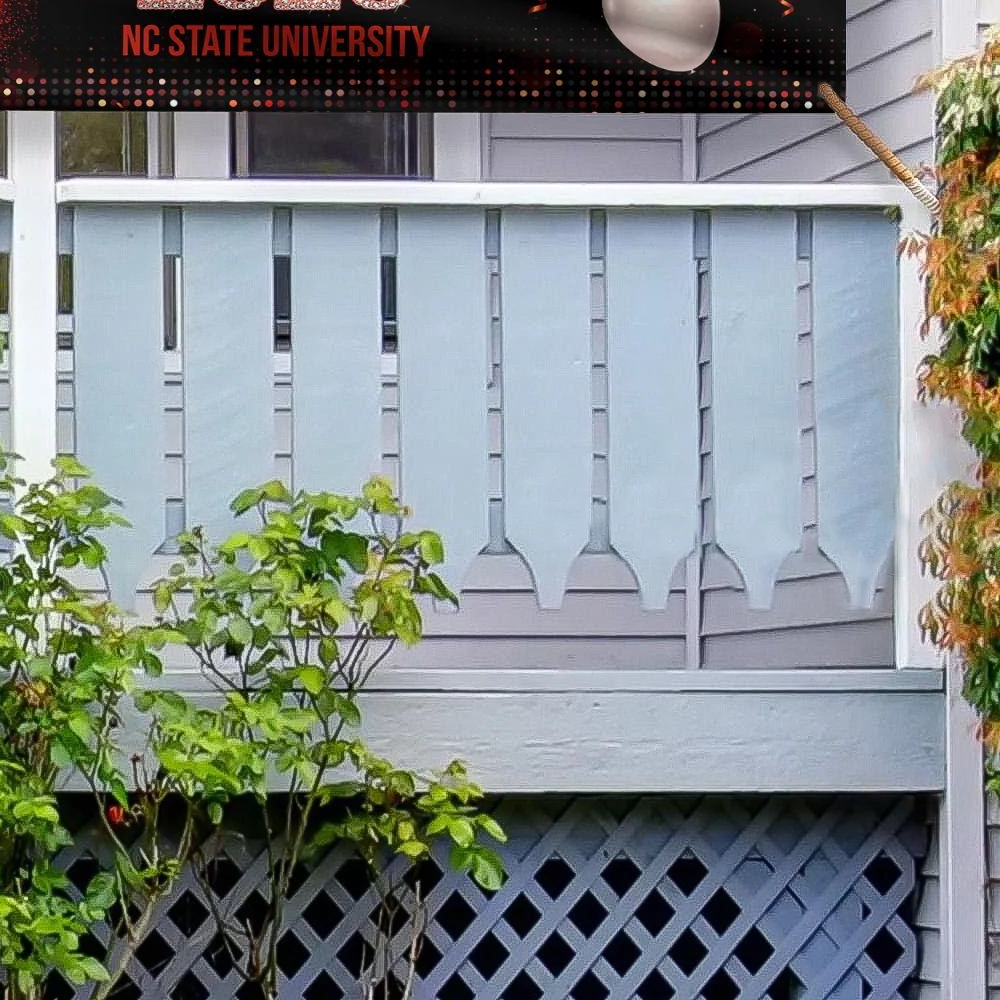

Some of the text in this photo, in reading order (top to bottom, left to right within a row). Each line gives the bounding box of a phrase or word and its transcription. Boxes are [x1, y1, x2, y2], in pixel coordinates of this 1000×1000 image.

[122, 24, 431, 58] NC STATE UNIVERSITY
